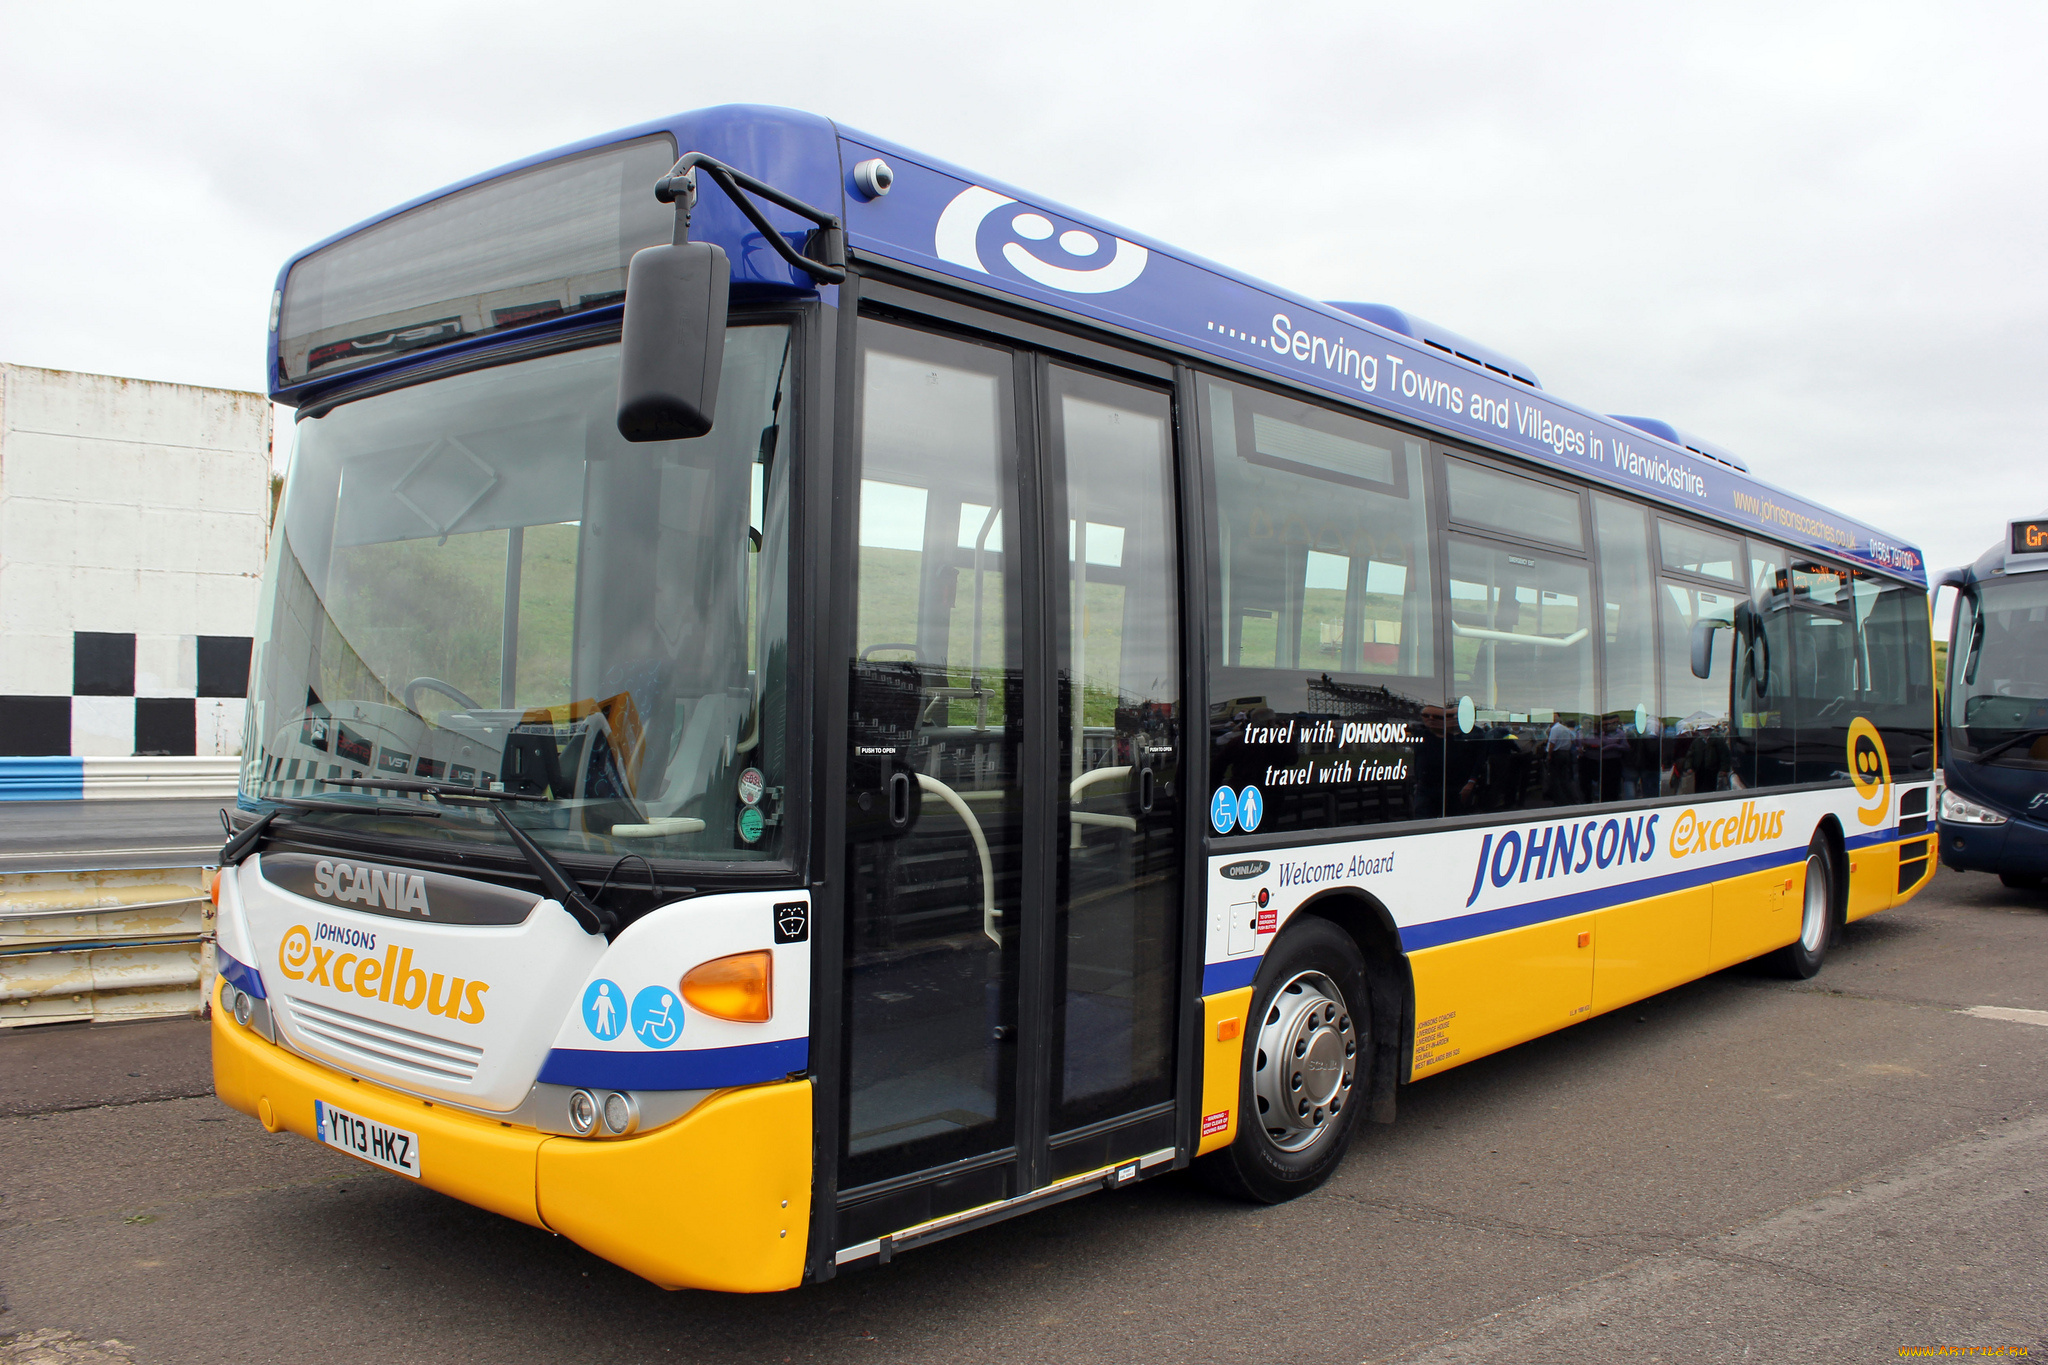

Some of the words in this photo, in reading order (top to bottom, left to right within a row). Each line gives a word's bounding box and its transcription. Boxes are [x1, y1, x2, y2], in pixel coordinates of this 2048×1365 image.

[1386, 355, 1463, 414] Towns
[1470, 397, 1509, 429] and
[1515, 402, 1585, 456] Villages
[1589, 430, 1604, 462] in
[1612, 438, 1708, 498] Warwickshire.
[1733, 490, 1857, 550] www.johnsonscoaches.co.uk
[1244, 720, 1294, 744] travel
[1300, 720, 1334, 743] with
[1265, 761, 1314, 786] travel
[1319, 760, 1352, 783] with
[1357, 758, 1408, 782] friends
[1279, 862, 1342, 887] Welcome
[1346, 851, 1395, 878] Aboard
[1466, 813, 1660, 908] JOHNSONS
[314, 860, 430, 916] SCANIA
[314, 922, 377, 950] JOHNSONS
[1417, 1017, 1437, 1030] JOHNSONS
[1438, 1011, 1456, 1022] COACHES
[1437, 1021, 1450, 1030] HOUSE
[1415, 1060, 1425, 1070] WEST
[1426, 1053, 1445, 1066] MIDLANDS
[329, 1109, 367, 1152] YT13
[371, 1125, 411, 1169] HKZ
